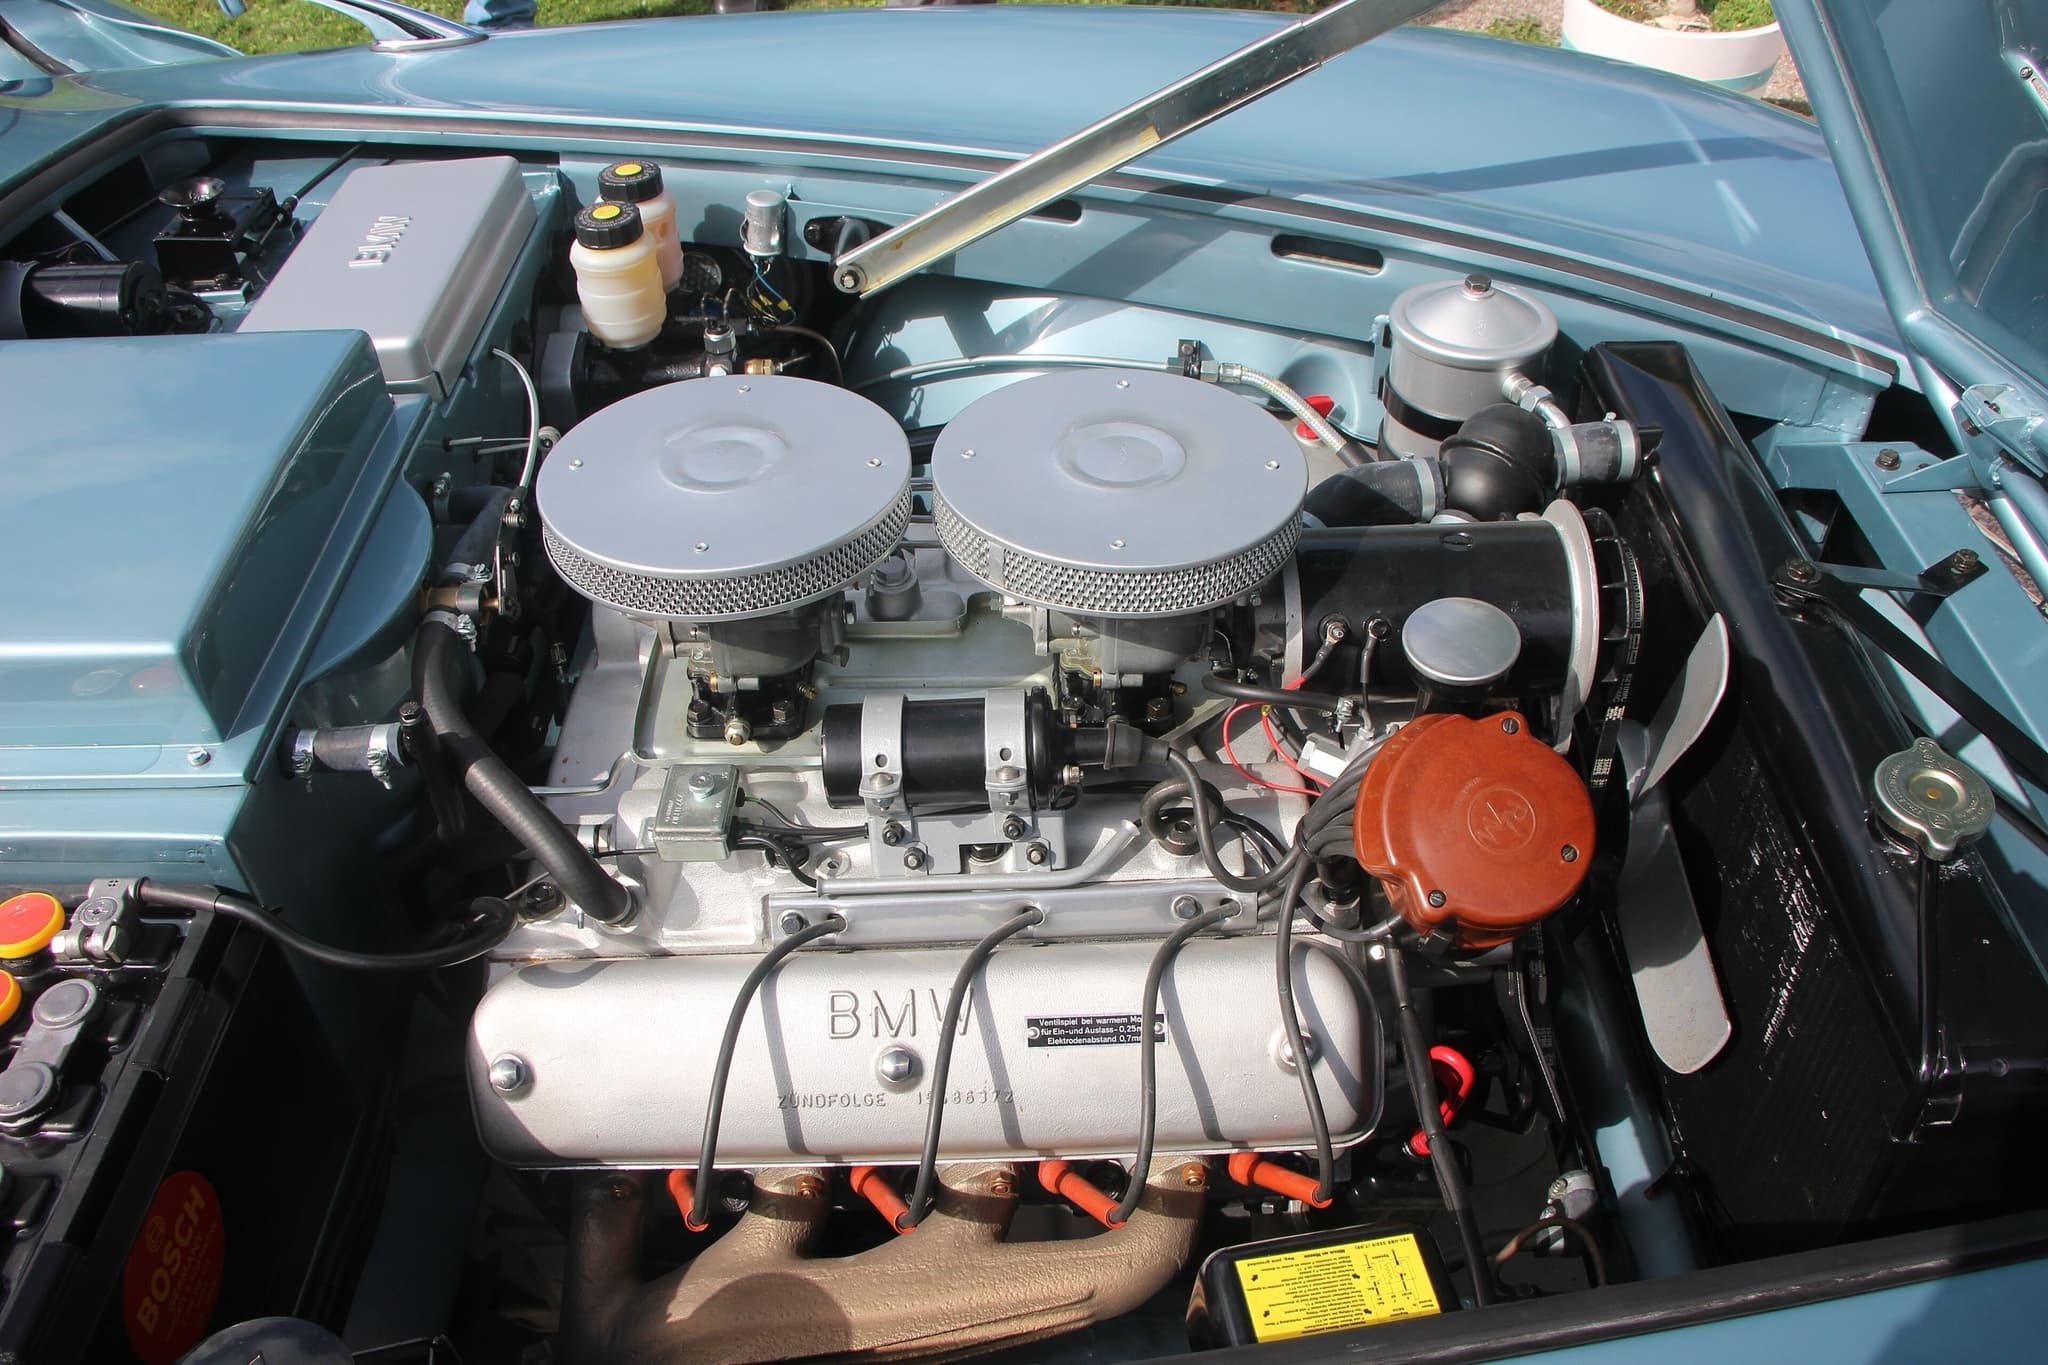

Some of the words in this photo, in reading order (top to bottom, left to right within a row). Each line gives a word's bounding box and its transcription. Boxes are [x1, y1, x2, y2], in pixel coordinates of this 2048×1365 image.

[348, 215, 411, 267] BMW
[828, 988, 975, 1039] BMW
[1039, 1017, 1078, 1027] Ventilspiel
[1081, 1016, 1093, 1025] bei
[1095, 1016, 1127, 1025] warmem
[1041, 1028, 1053, 1036] für
[1119, 1024, 1142, 1033] 0,25m
[1047, 1035, 1117, 1045] Elektrodenabstand
[777, 1090, 887, 1109] ZÜNDFOLGE
[136, 1183, 206, 1336] BOSCH
